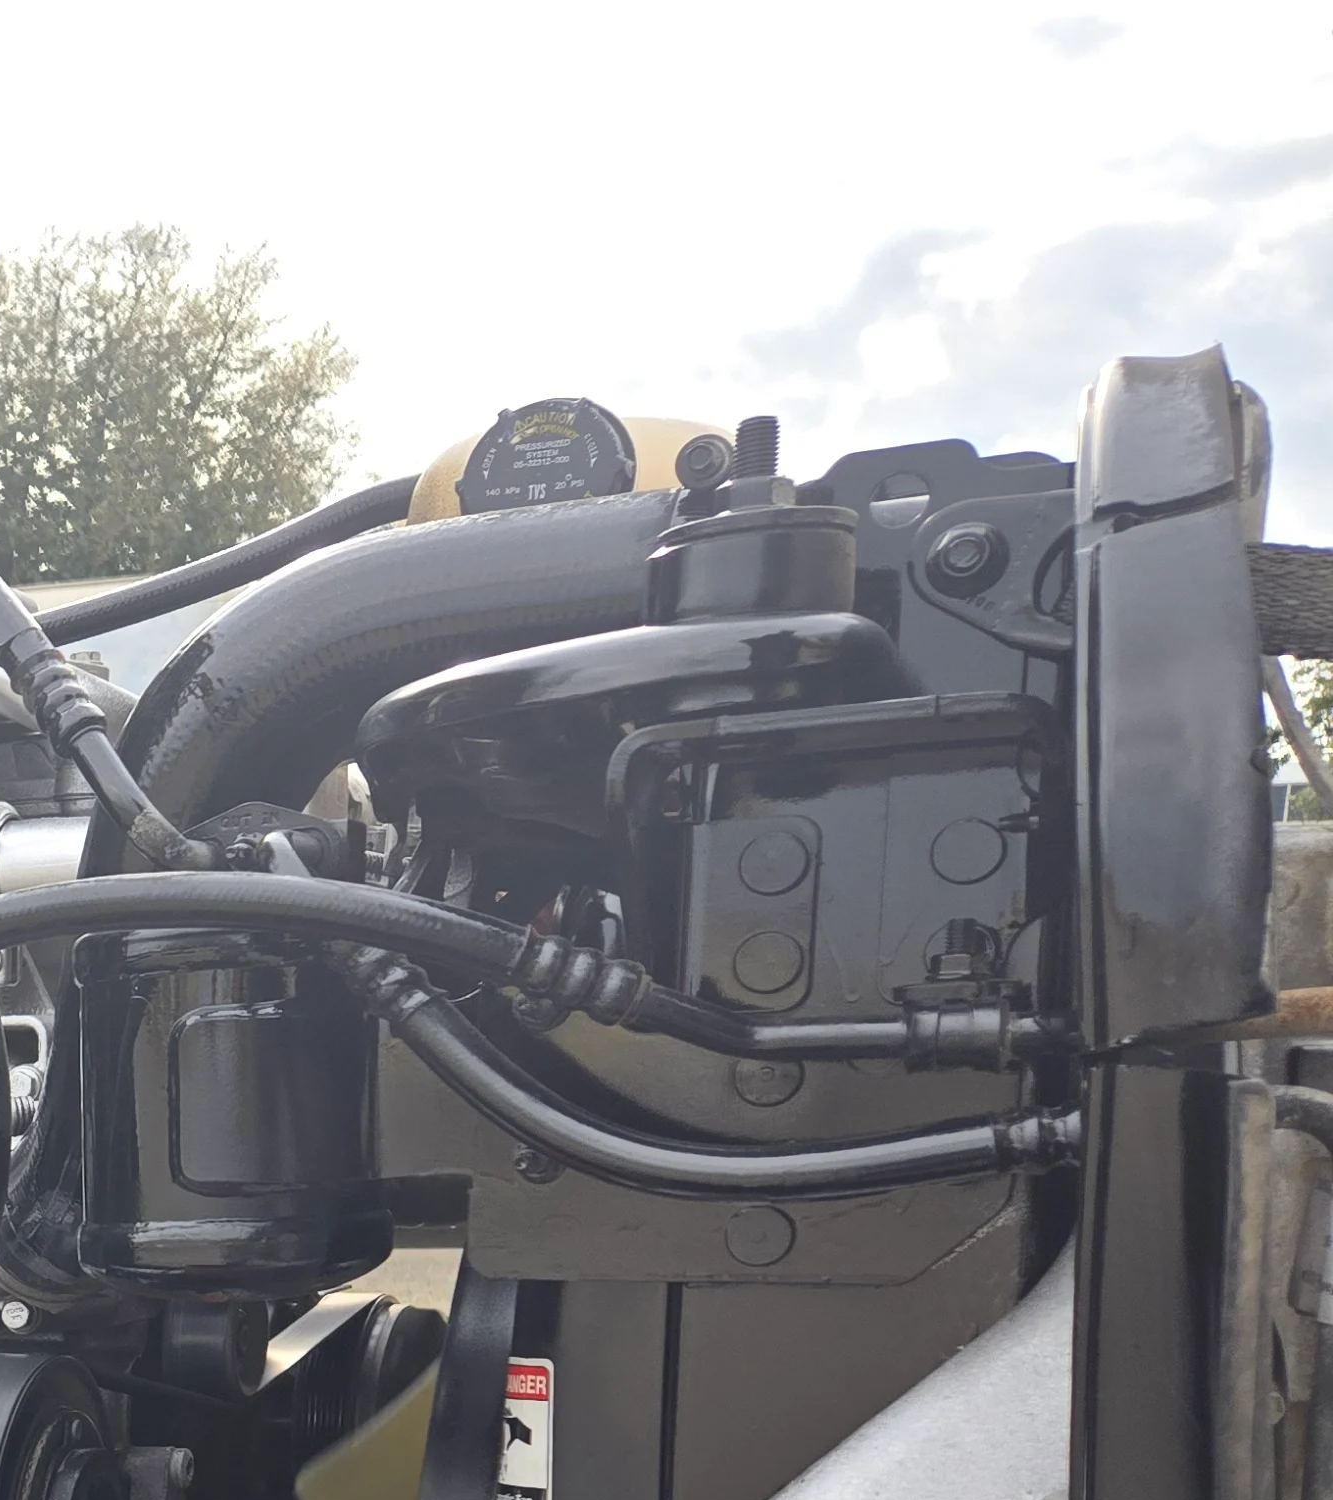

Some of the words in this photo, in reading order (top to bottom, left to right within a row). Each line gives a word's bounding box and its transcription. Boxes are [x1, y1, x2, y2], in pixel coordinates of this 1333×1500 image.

[525, 411, 576, 426] CAUTION
[514, 438, 572, 452] PRESSURIZED
[525, 449, 560, 460] SYSTEM
[527, 483, 547, 500] TVS
[554, 481, 567, 490] 20
[506, 1374, 547, 1395] ANGER
